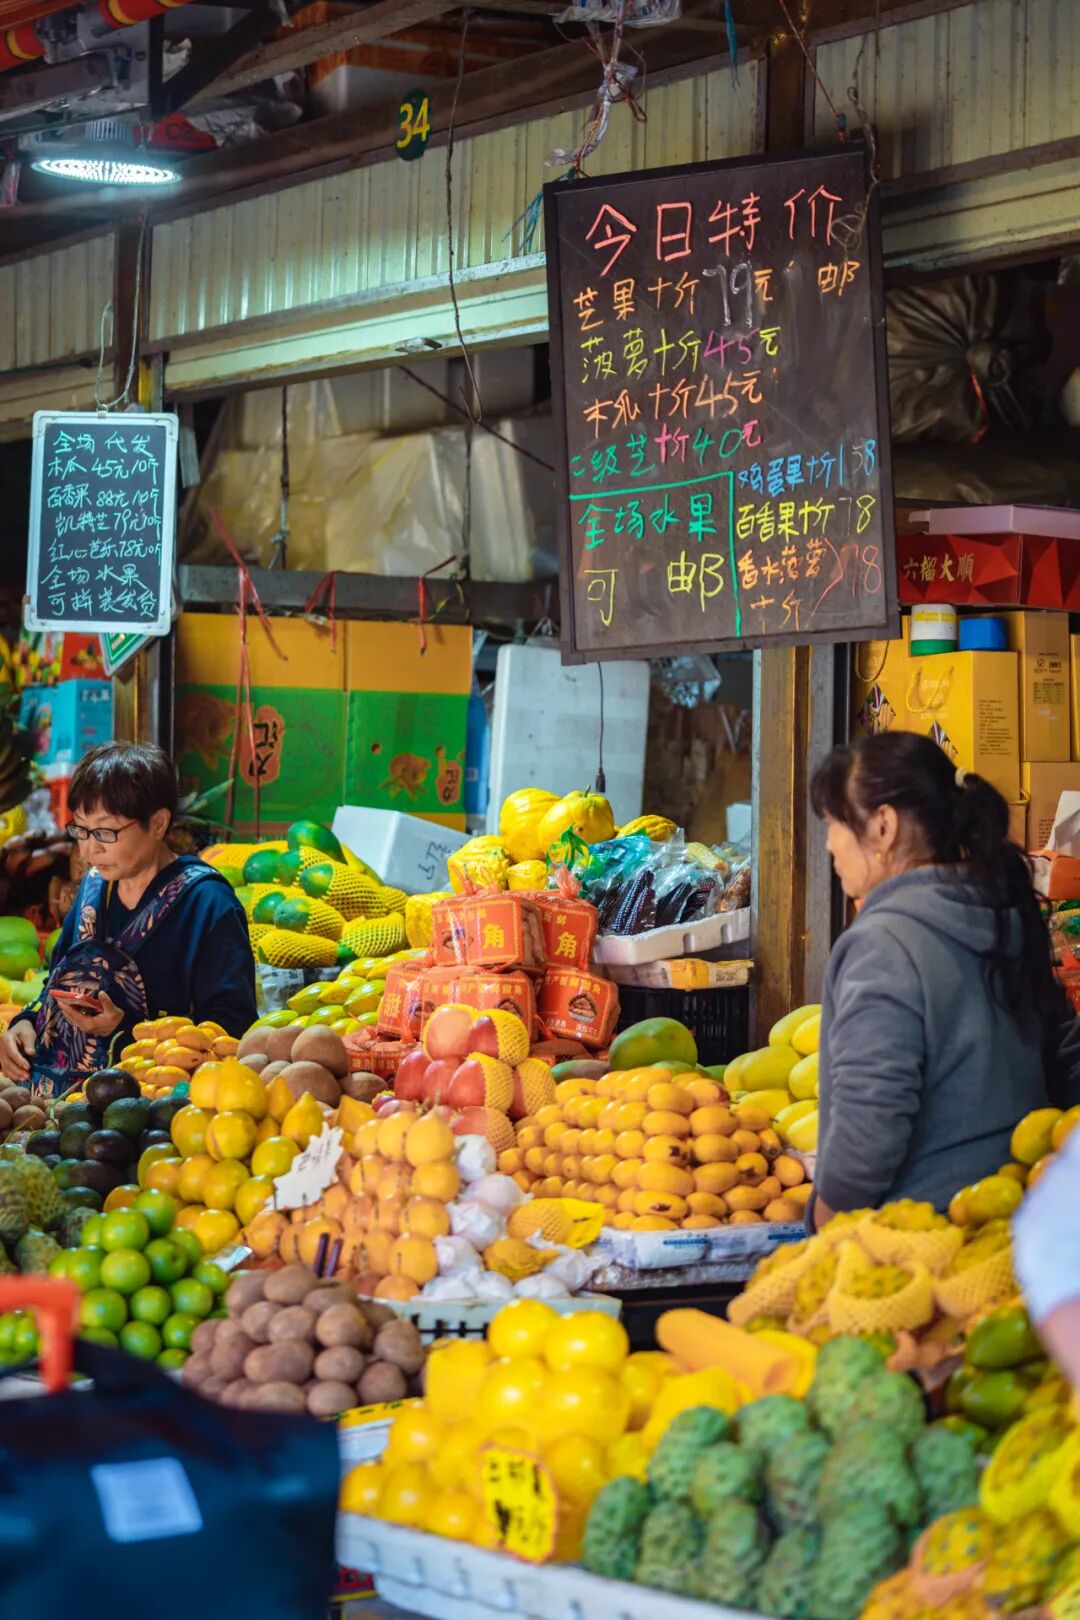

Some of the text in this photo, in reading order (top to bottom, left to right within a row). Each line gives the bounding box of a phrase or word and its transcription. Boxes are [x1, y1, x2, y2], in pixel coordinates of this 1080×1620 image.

[397, 97, 431, 149] 34
[586, 185, 843, 276] 今日特价
[578, 492, 717, 550] 全场水果
[41, 564, 148, 590] 全场水果
